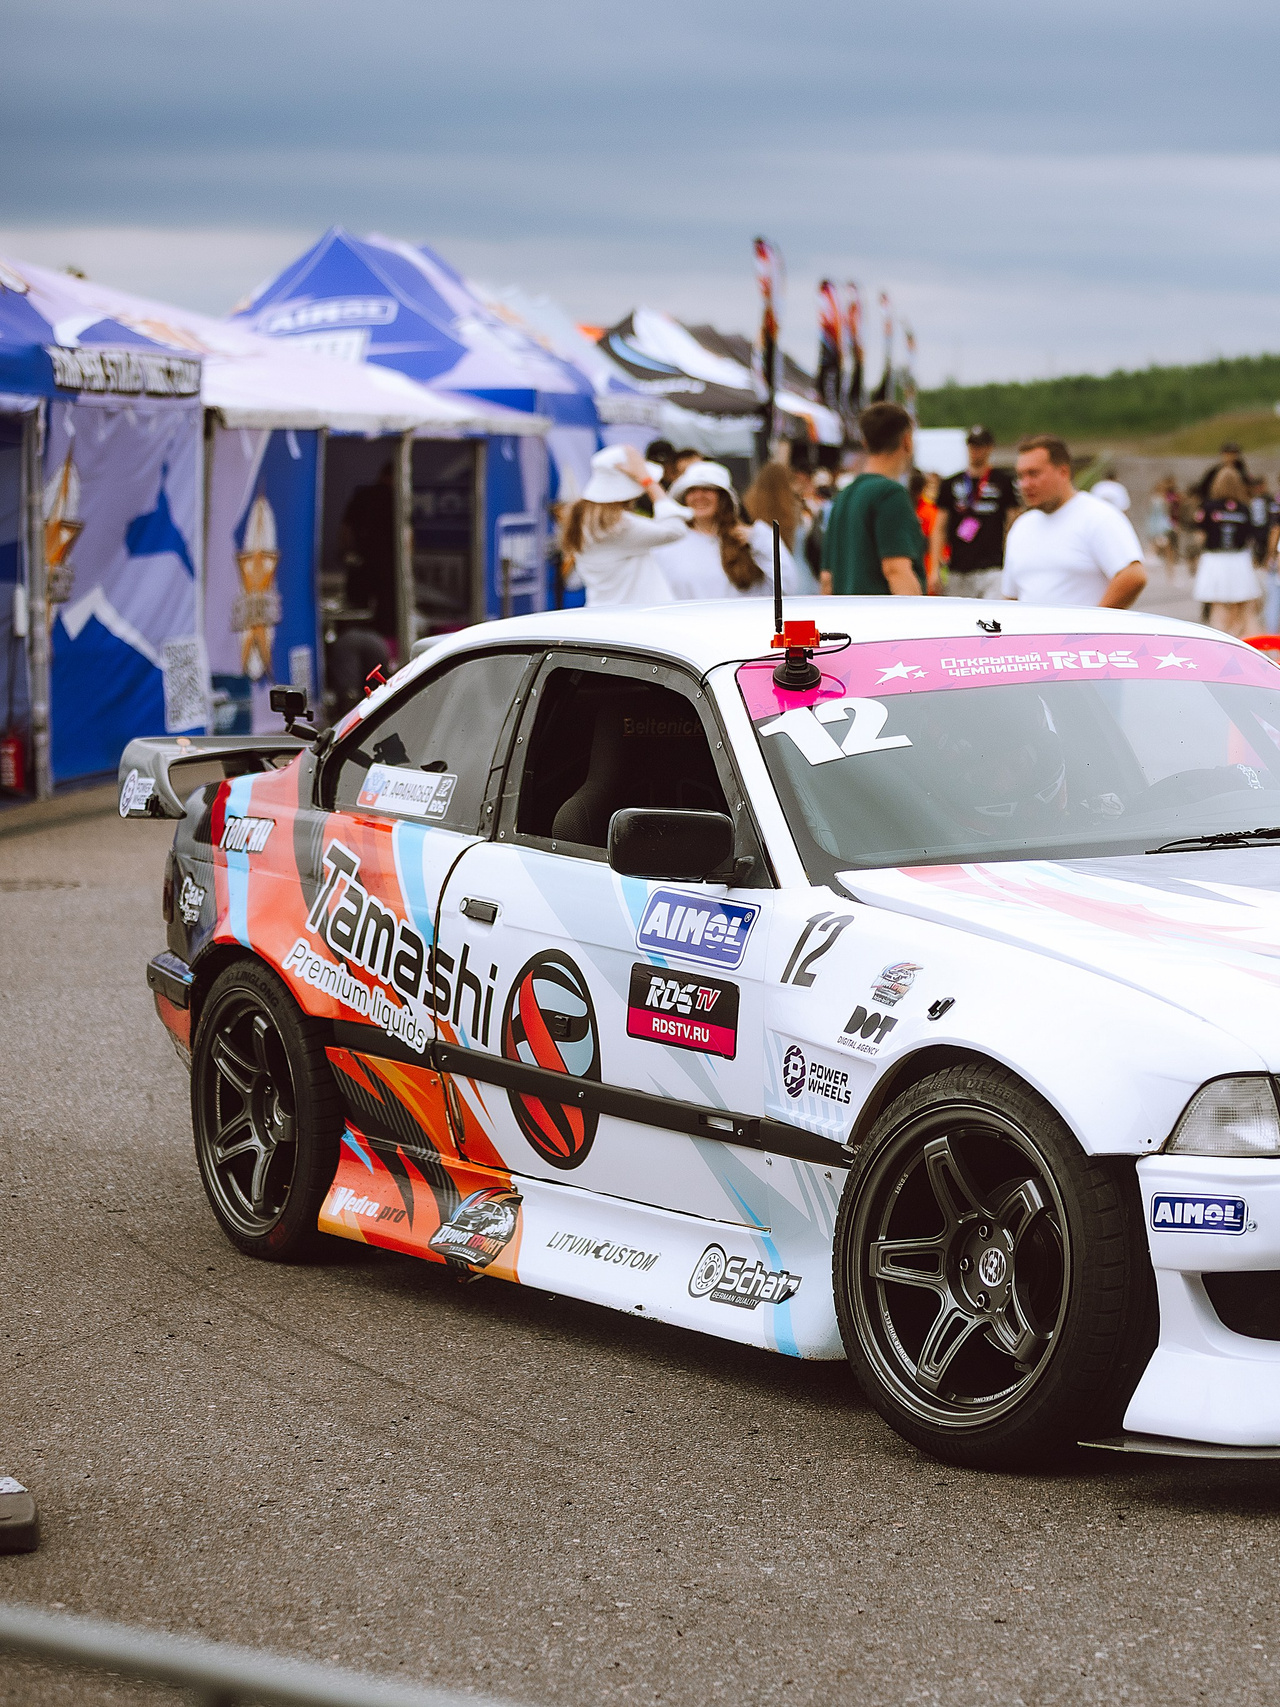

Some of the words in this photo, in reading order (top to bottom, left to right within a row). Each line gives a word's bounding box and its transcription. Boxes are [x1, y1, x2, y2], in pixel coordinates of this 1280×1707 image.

[1046, 650, 1139, 670] RDS
[758, 697, 913, 766] 12
[309, 843, 498, 1047] Tamashi
[780, 911, 855, 988] 12
[289, 943, 368, 1012] Premium
[372, 988, 426, 1049] liquids
[652, 1017, 710, 1043] RDSTV.RU
[843, 1005, 898, 1044] DOT
[837, 1035, 858, 1051] DIGITAL
[856, 1043, 880, 1056] AGENCY
[807, 1079, 851, 1104] WHEELS
[809, 1062, 849, 1087] POWER
[328, 1187, 406, 1223] Vedro.pro
[718, 1258, 800, 1300] Schatz
[712, 1291, 736, 1303] GERMAN
[735, 1296, 758, 1308] QUALITY
